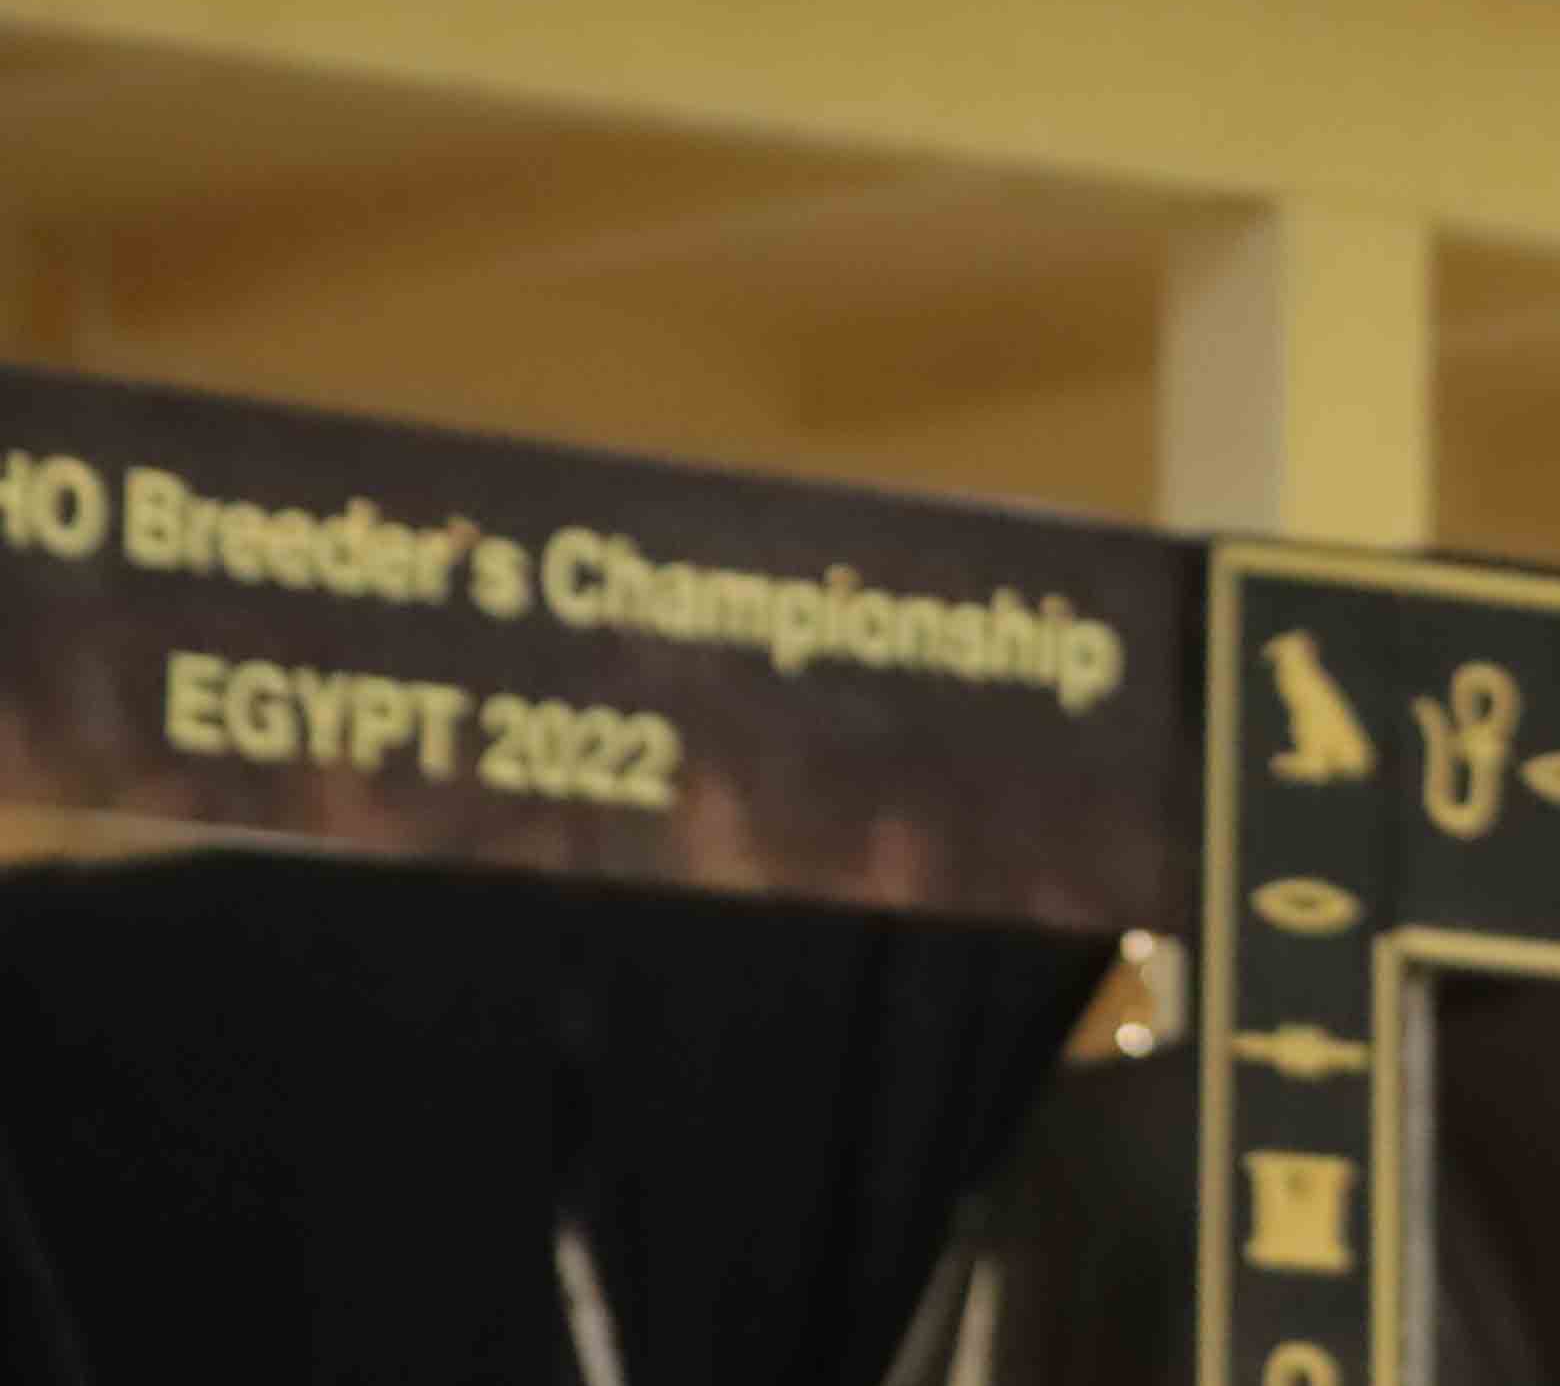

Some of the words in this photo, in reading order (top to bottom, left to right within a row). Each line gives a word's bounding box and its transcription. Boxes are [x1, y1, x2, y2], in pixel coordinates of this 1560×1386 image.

[542, 526, 1124, 711] Championship
[166, 651, 470, 779] EGYPT
[478, 693, 680, 810] 2022
